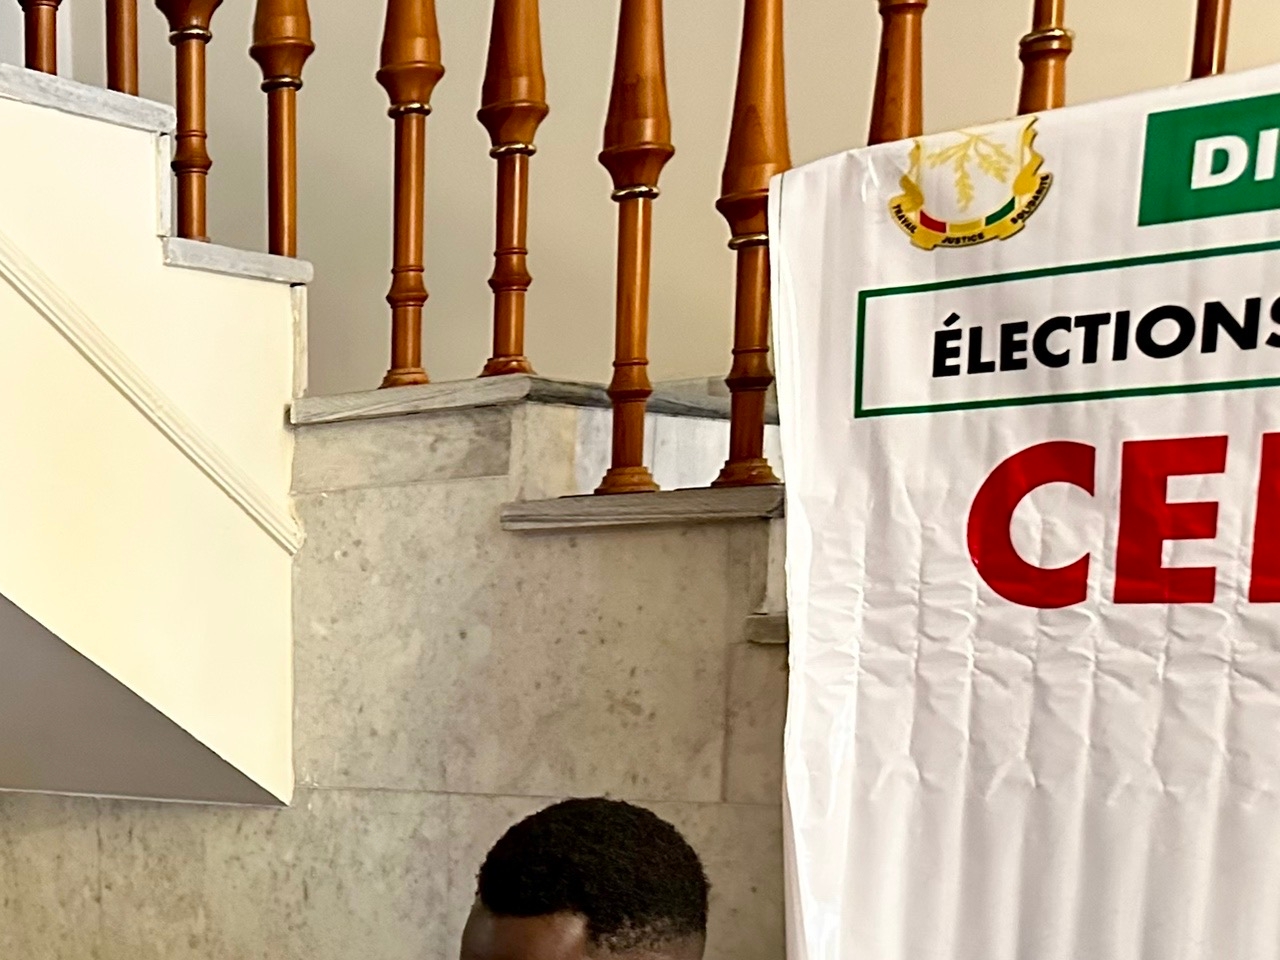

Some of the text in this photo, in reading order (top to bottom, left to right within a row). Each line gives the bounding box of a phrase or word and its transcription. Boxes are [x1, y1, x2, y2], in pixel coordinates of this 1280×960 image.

[1190, 128, 1278, 190] DI
[891, 203, 918, 235] TRAVAIL
[941, 232, 985, 245] JUSTICE
